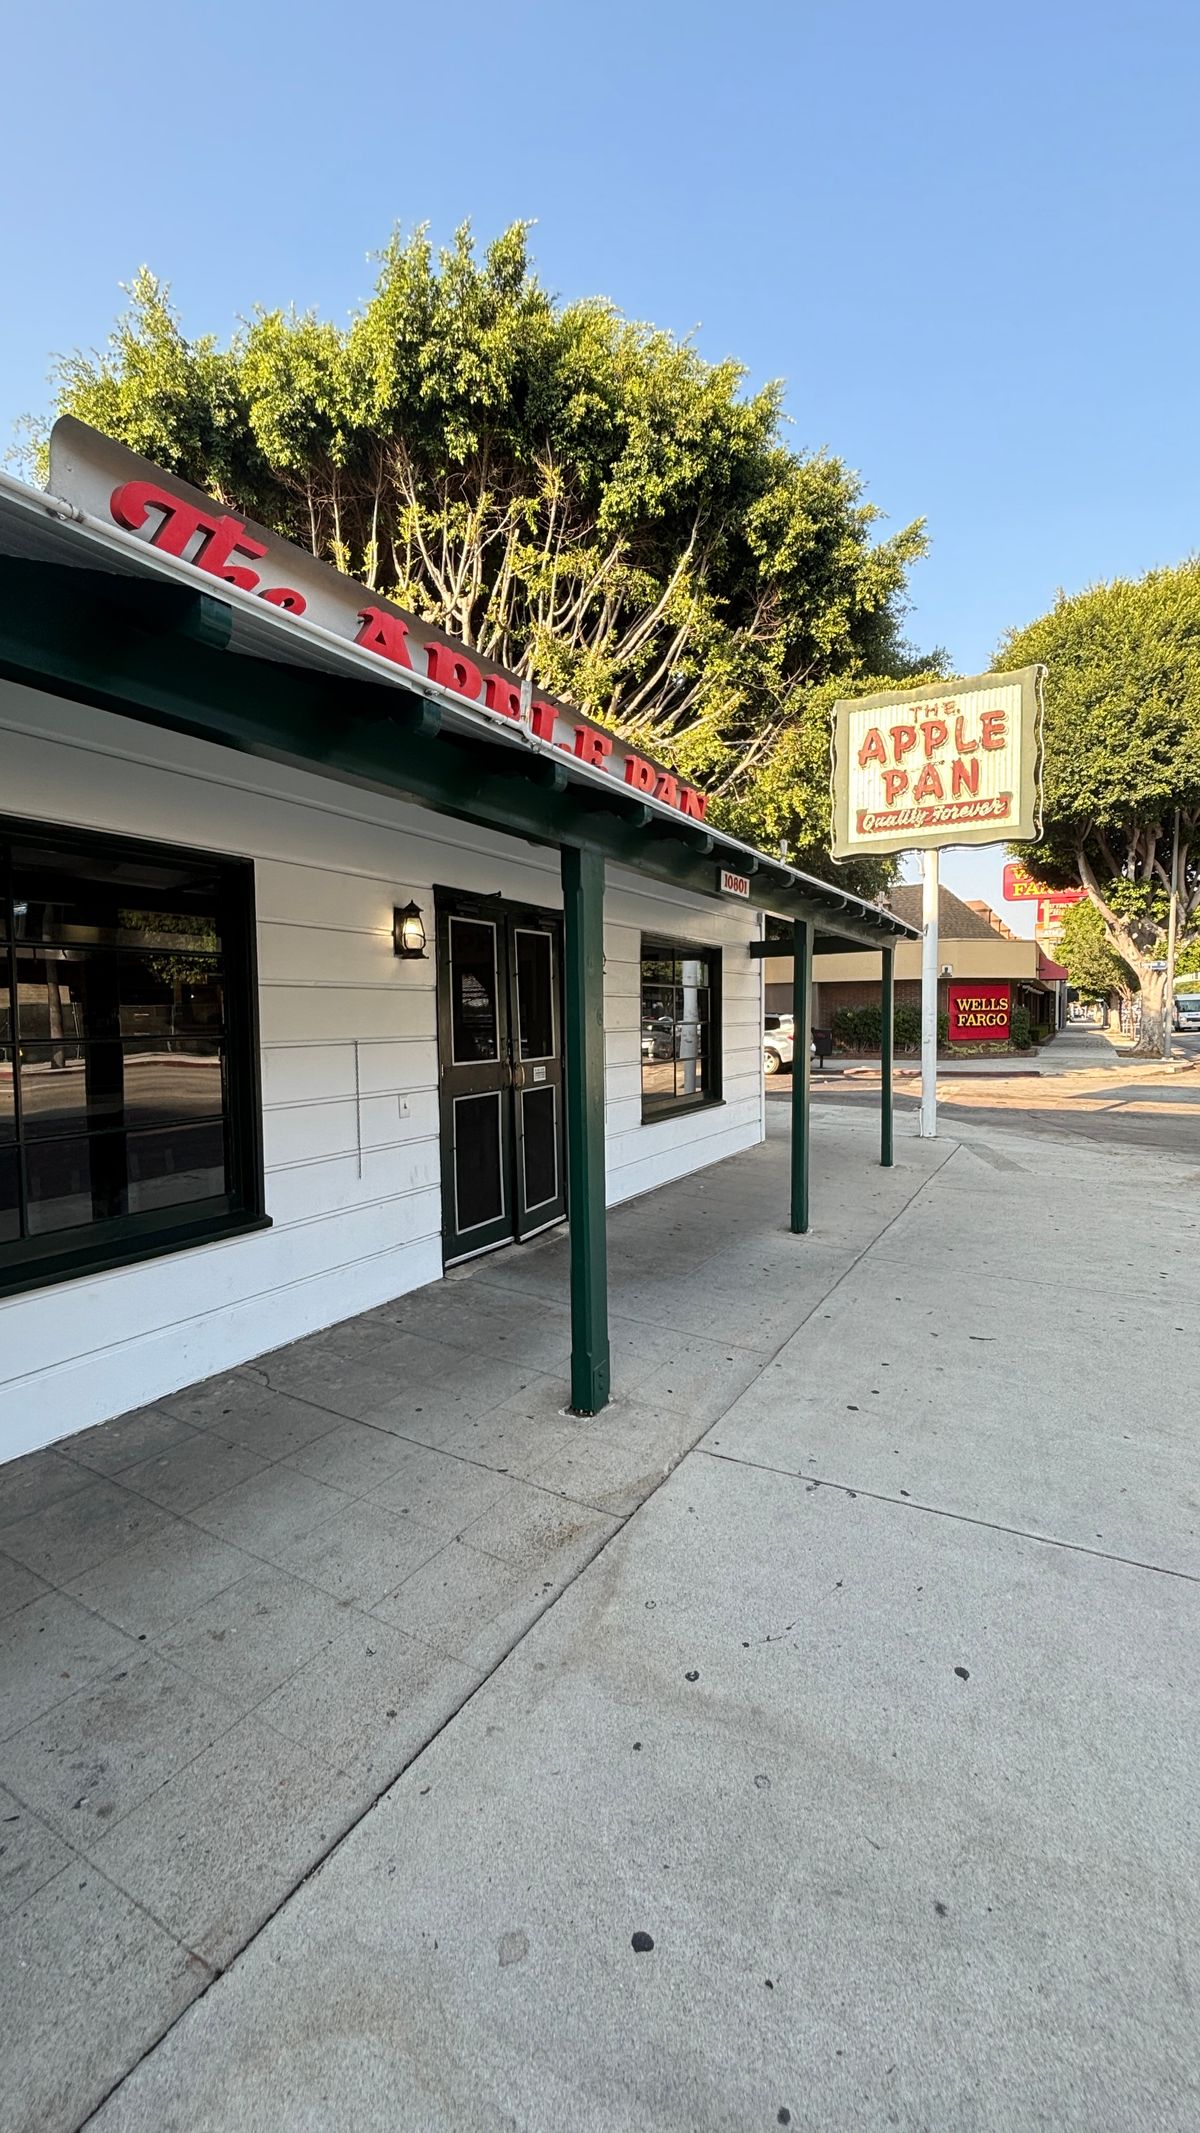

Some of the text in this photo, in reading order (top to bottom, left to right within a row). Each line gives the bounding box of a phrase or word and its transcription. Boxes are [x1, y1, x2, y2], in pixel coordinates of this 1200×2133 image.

[110, 481, 307, 617] The
[624, 755, 708, 822] PAN
[909, 701, 957, 723] THE
[858, 709, 1008, 768] APPLE
[881, 757, 980, 806] PAN
[862, 796, 1006, 831] Quality Forever
[956, 998, 1008, 1011] WELLS
[957, 1013, 1007, 1026] FARGO
